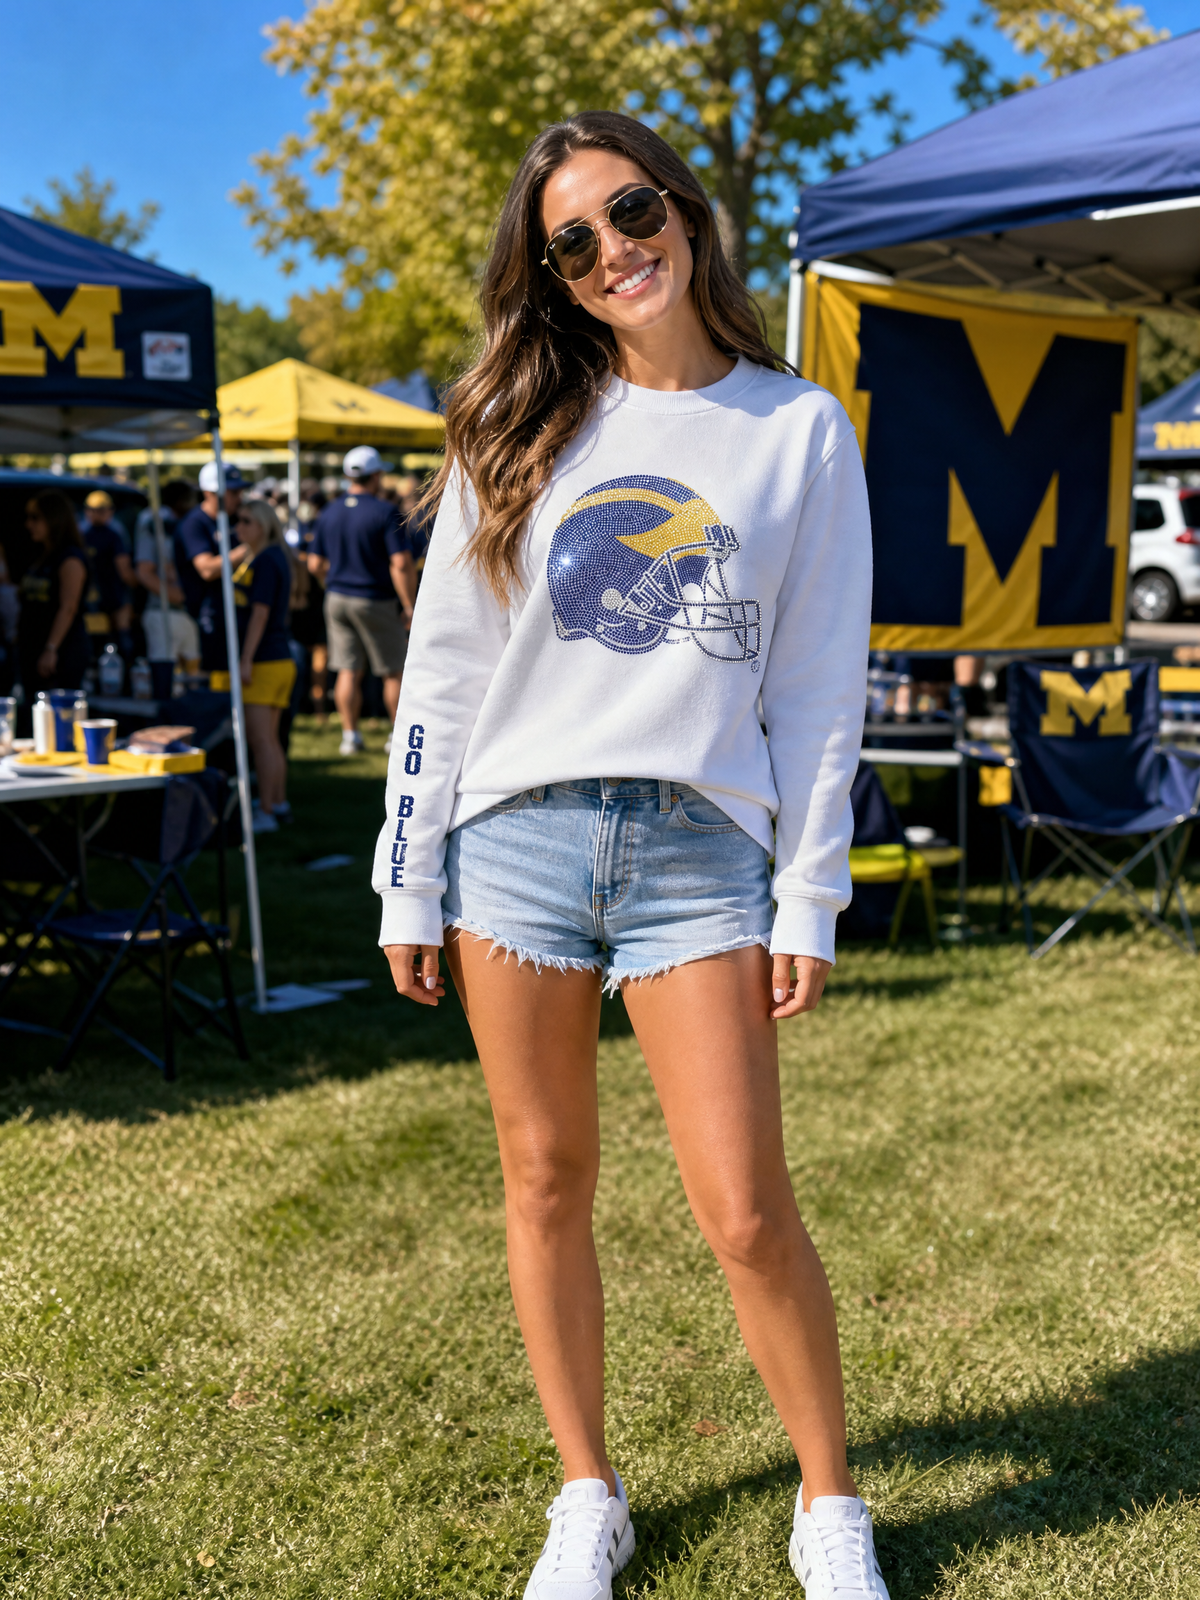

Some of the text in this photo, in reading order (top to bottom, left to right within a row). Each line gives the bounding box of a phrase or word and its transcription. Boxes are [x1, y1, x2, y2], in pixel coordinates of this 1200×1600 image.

[0, 280, 124, 379] M
[855, 302, 1128, 628] M
[1040, 669, 1132, 737] M
[391, 724, 425, 888] GO BLUE
